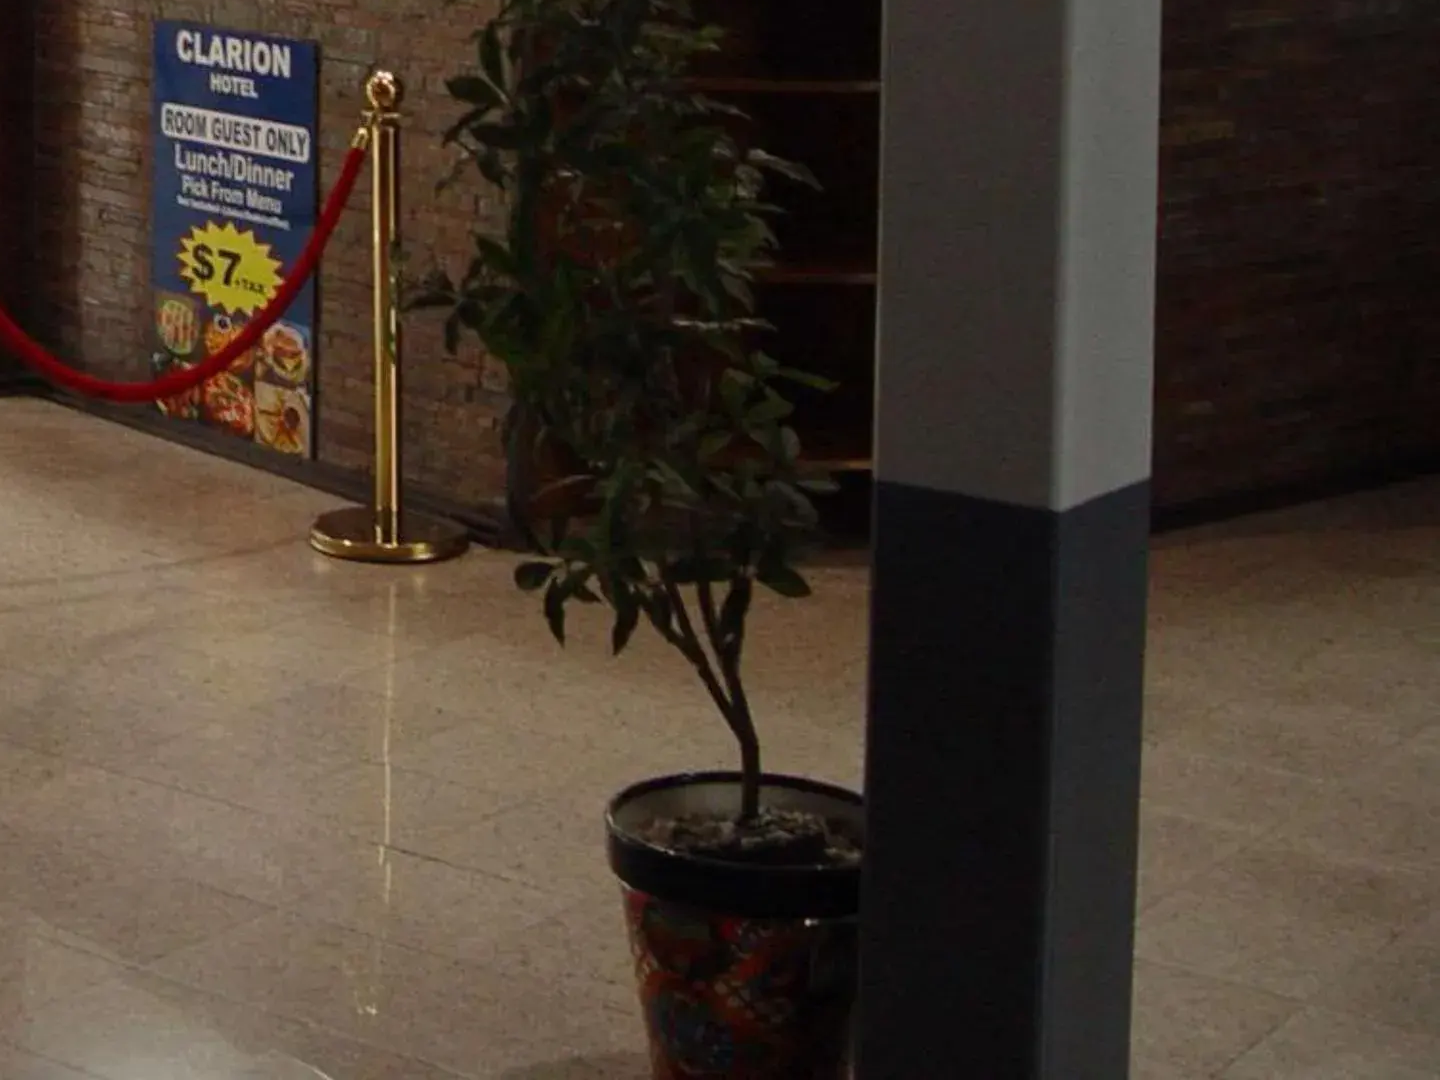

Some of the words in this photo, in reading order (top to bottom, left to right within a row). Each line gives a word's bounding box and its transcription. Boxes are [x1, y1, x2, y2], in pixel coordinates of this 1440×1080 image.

[176, 30, 291, 78] CLARION
[210, 72, 258, 98] HOTEL
[165, 108, 207, 137] ROOM
[212, 118, 261, 149] GUEST
[266, 127, 307, 157] ONLY
[174, 141, 294, 191] Lunch/Dinner
[181, 174, 209, 198] Pick
[211, 180, 244, 205] From
[246, 187, 282, 214] Menu
[192, 243, 241, 287] $7
